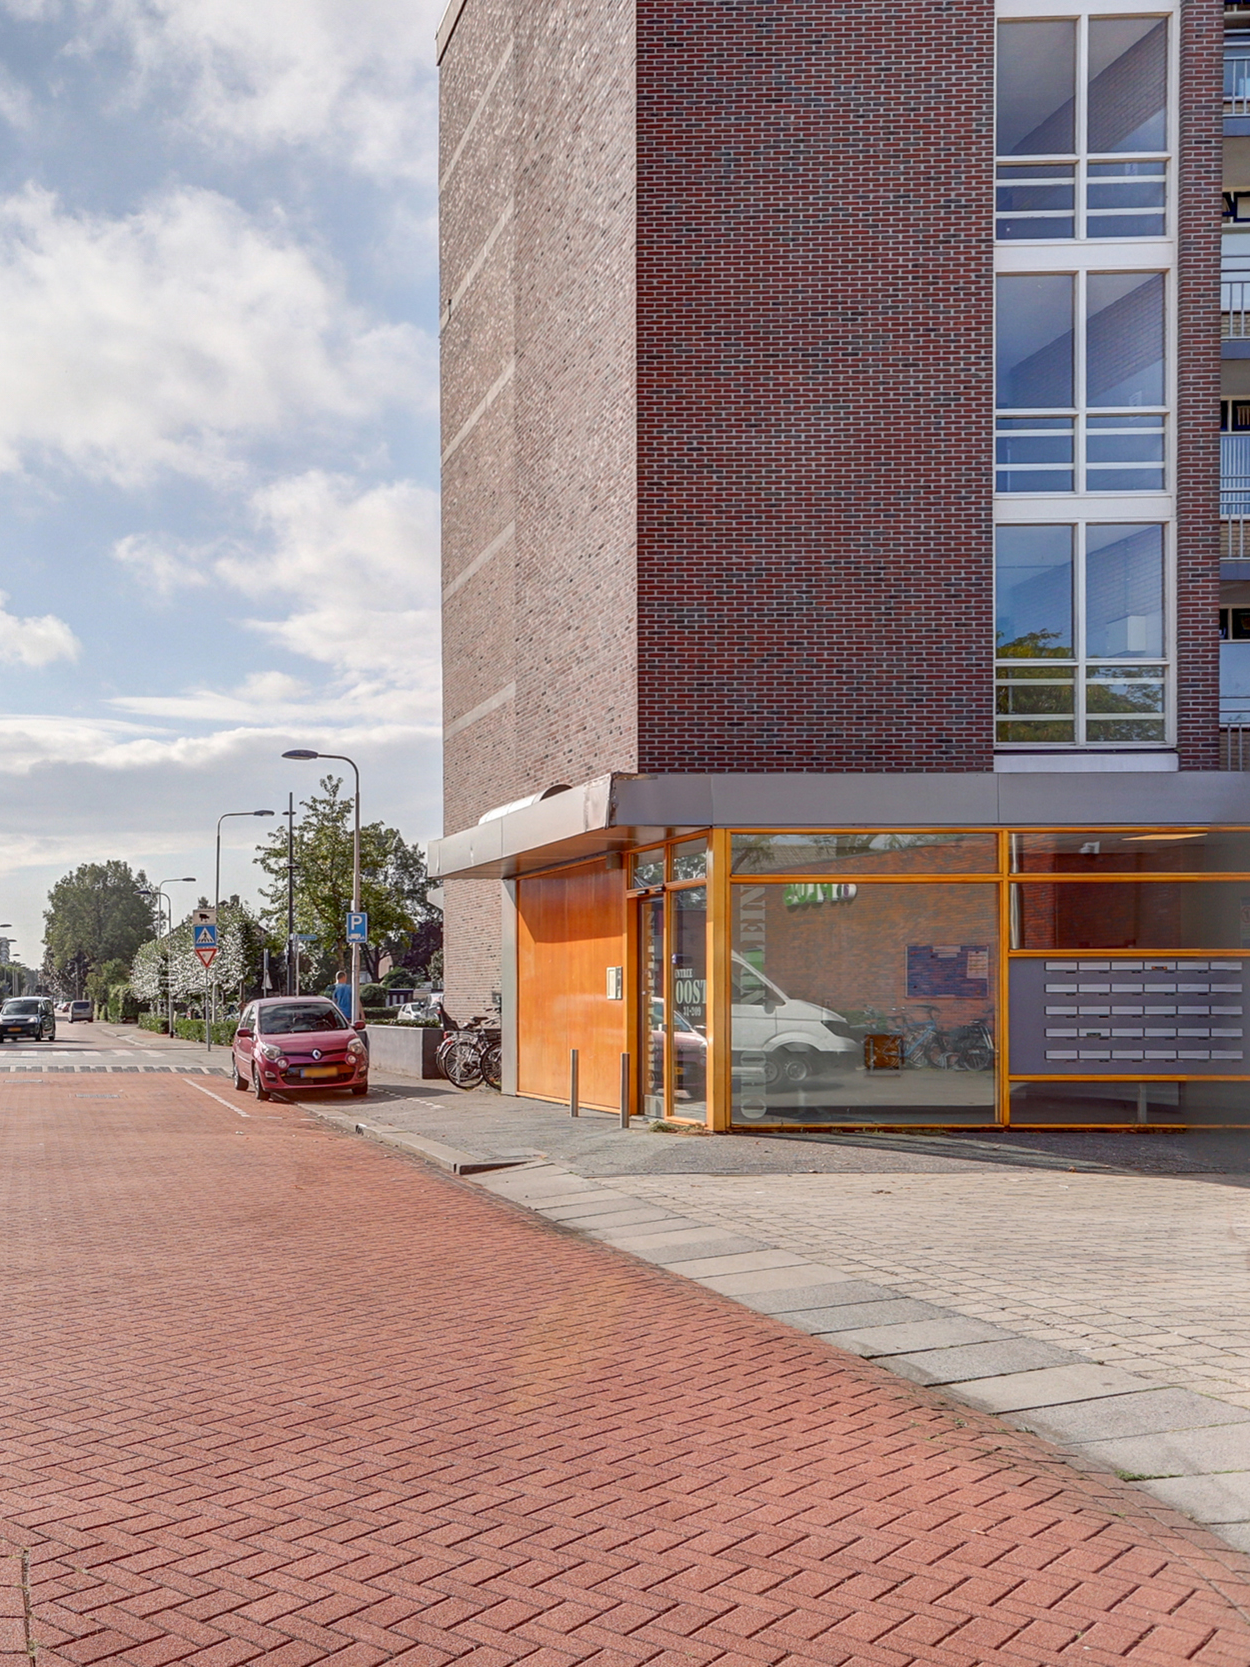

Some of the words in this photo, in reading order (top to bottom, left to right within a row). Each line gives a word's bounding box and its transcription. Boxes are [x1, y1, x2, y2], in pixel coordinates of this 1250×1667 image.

[351, 915, 363, 930] P
[676, 980, 706, 1004] OOST
[740, 885, 766, 1119] CHONPLEIN
